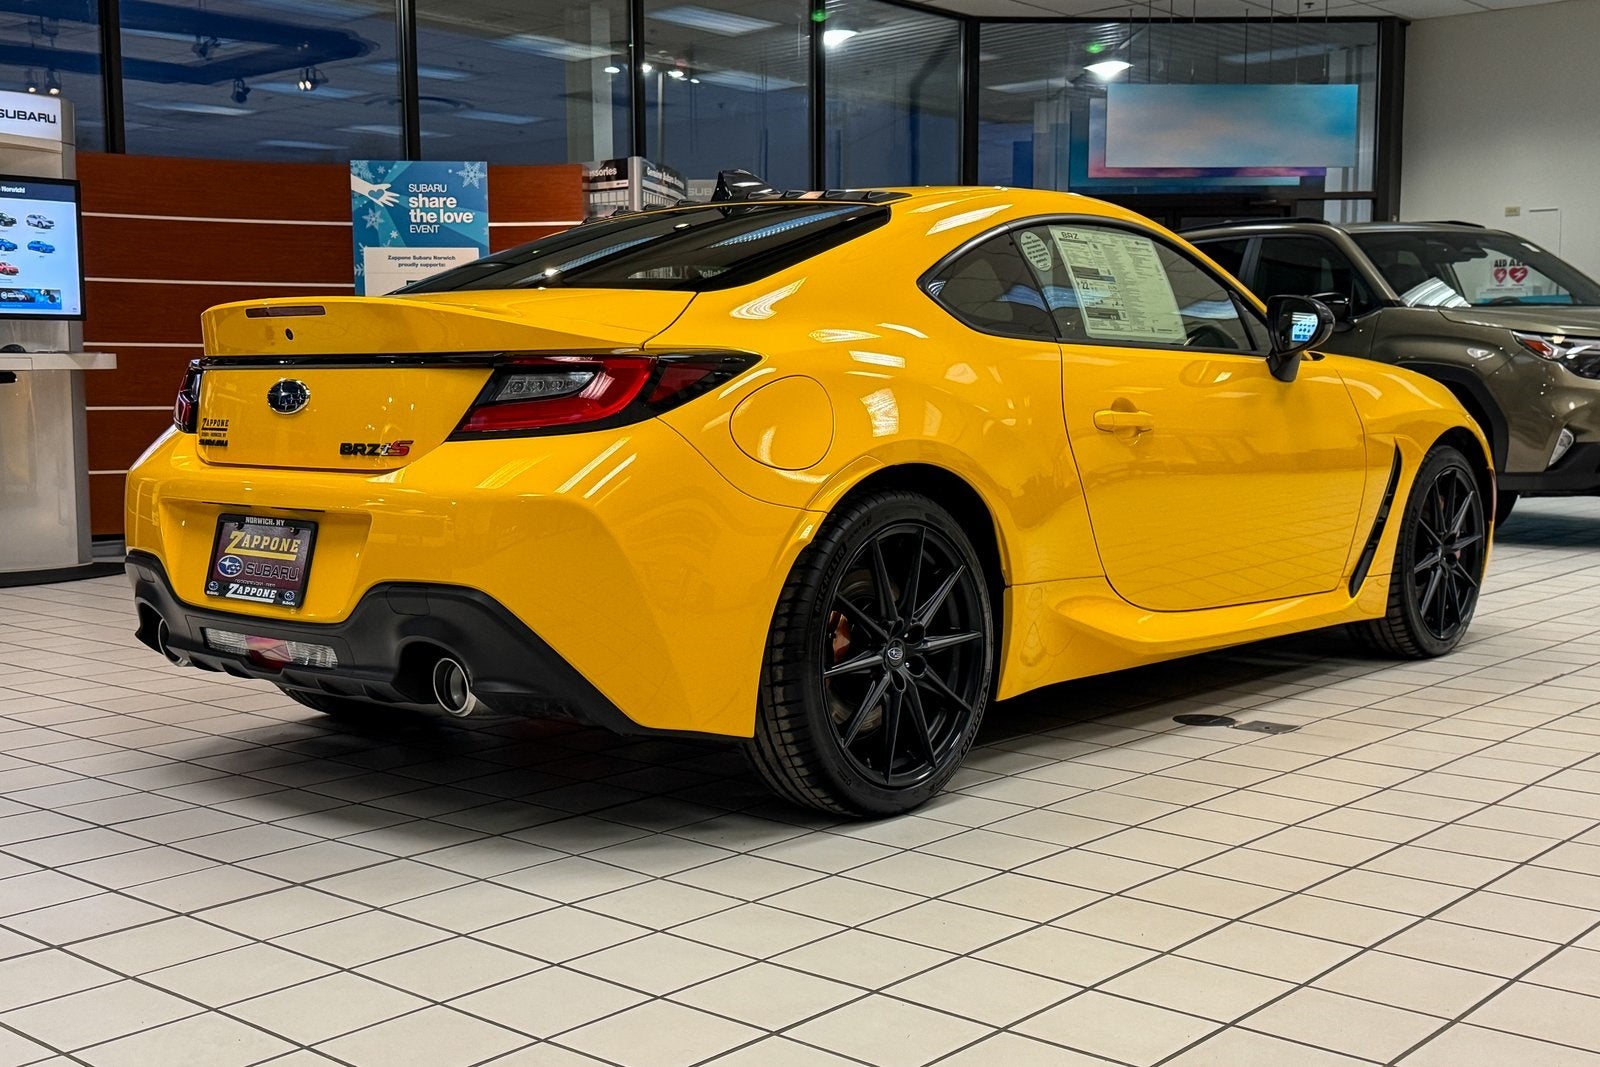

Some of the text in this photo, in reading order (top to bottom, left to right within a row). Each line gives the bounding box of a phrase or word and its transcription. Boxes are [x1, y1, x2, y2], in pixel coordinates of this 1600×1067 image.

[408, 183, 447, 193] SUBARU
[408, 193, 457, 208] share
[409, 209, 473, 224] the love
[409, 224, 440, 234] EVENT
[1061, 231, 1079, 240] BRZ
[1494, 259, 1507, 267] AED
[340, 442, 381, 456] BRZ
[225, 530, 302, 558] ZAPPONE
[244, 562, 300, 582] SUBARU
[225, 583, 277, 601] ZAPPONE
